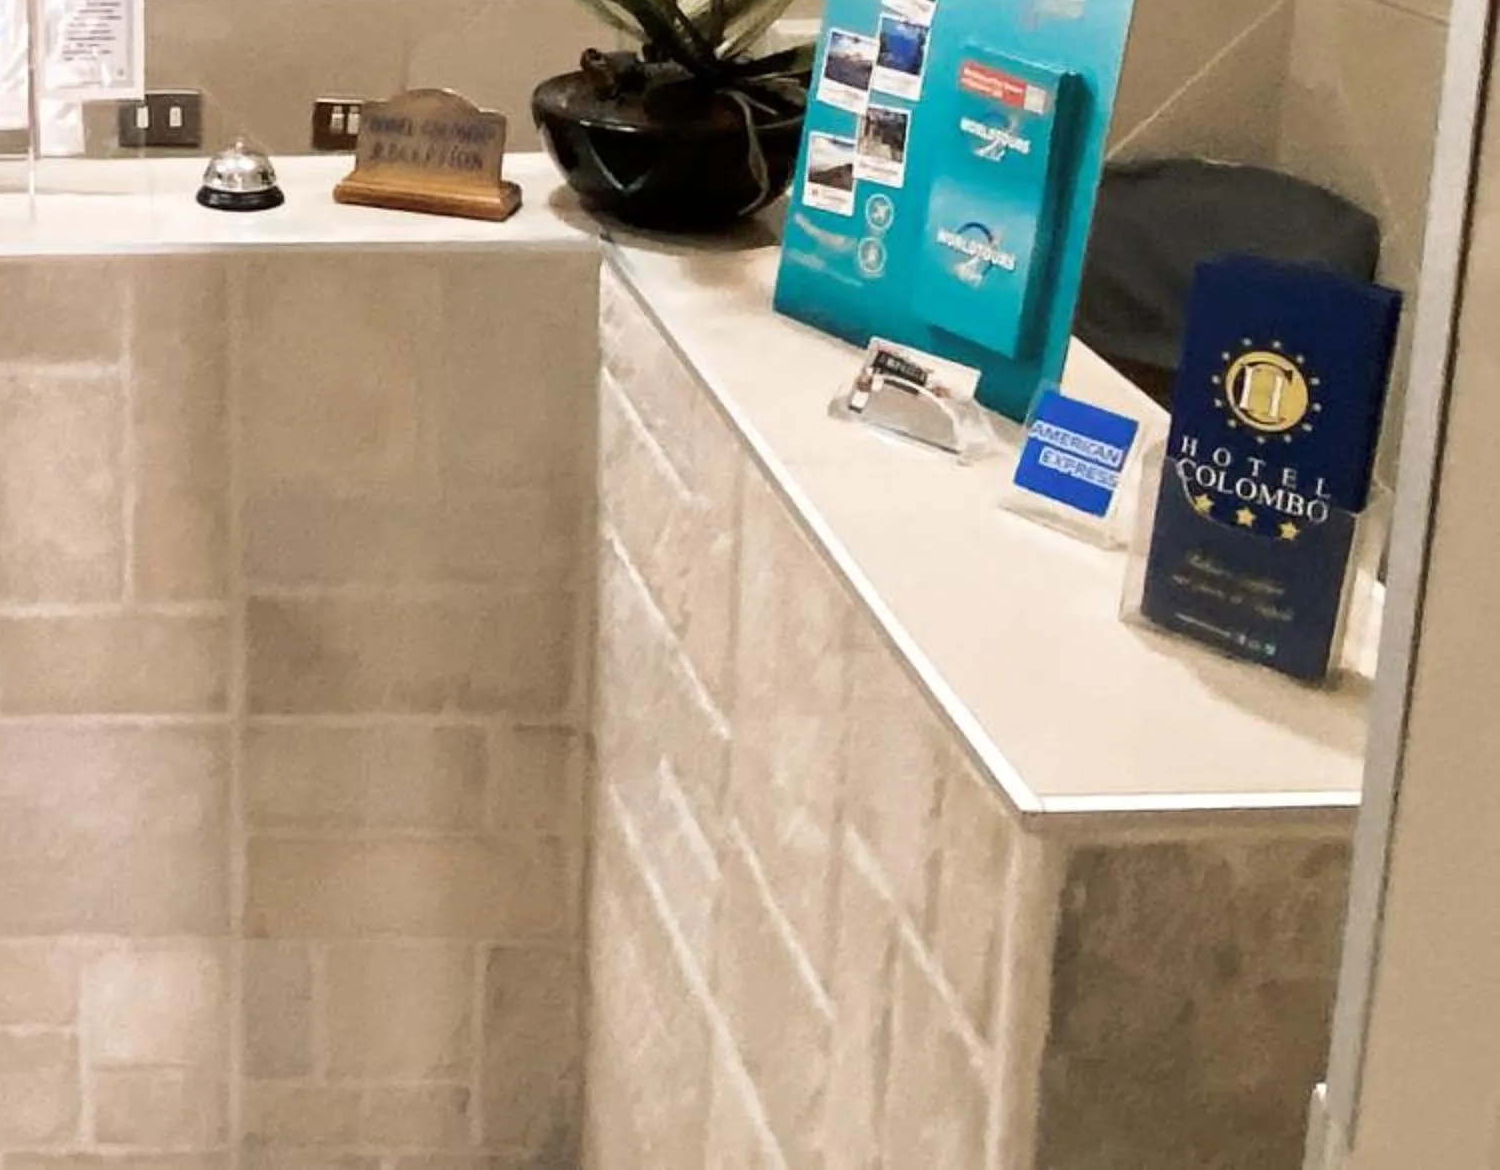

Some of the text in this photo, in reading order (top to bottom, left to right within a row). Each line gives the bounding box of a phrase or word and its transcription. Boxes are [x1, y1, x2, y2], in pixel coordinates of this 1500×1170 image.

[1028, 419, 1124, 469] AMERICAN
[1038, 445, 1120, 491] EXPRESS
[1181, 434, 1332, 500] HOTEL
[1176, 459, 1329, 524] COLOMBO
